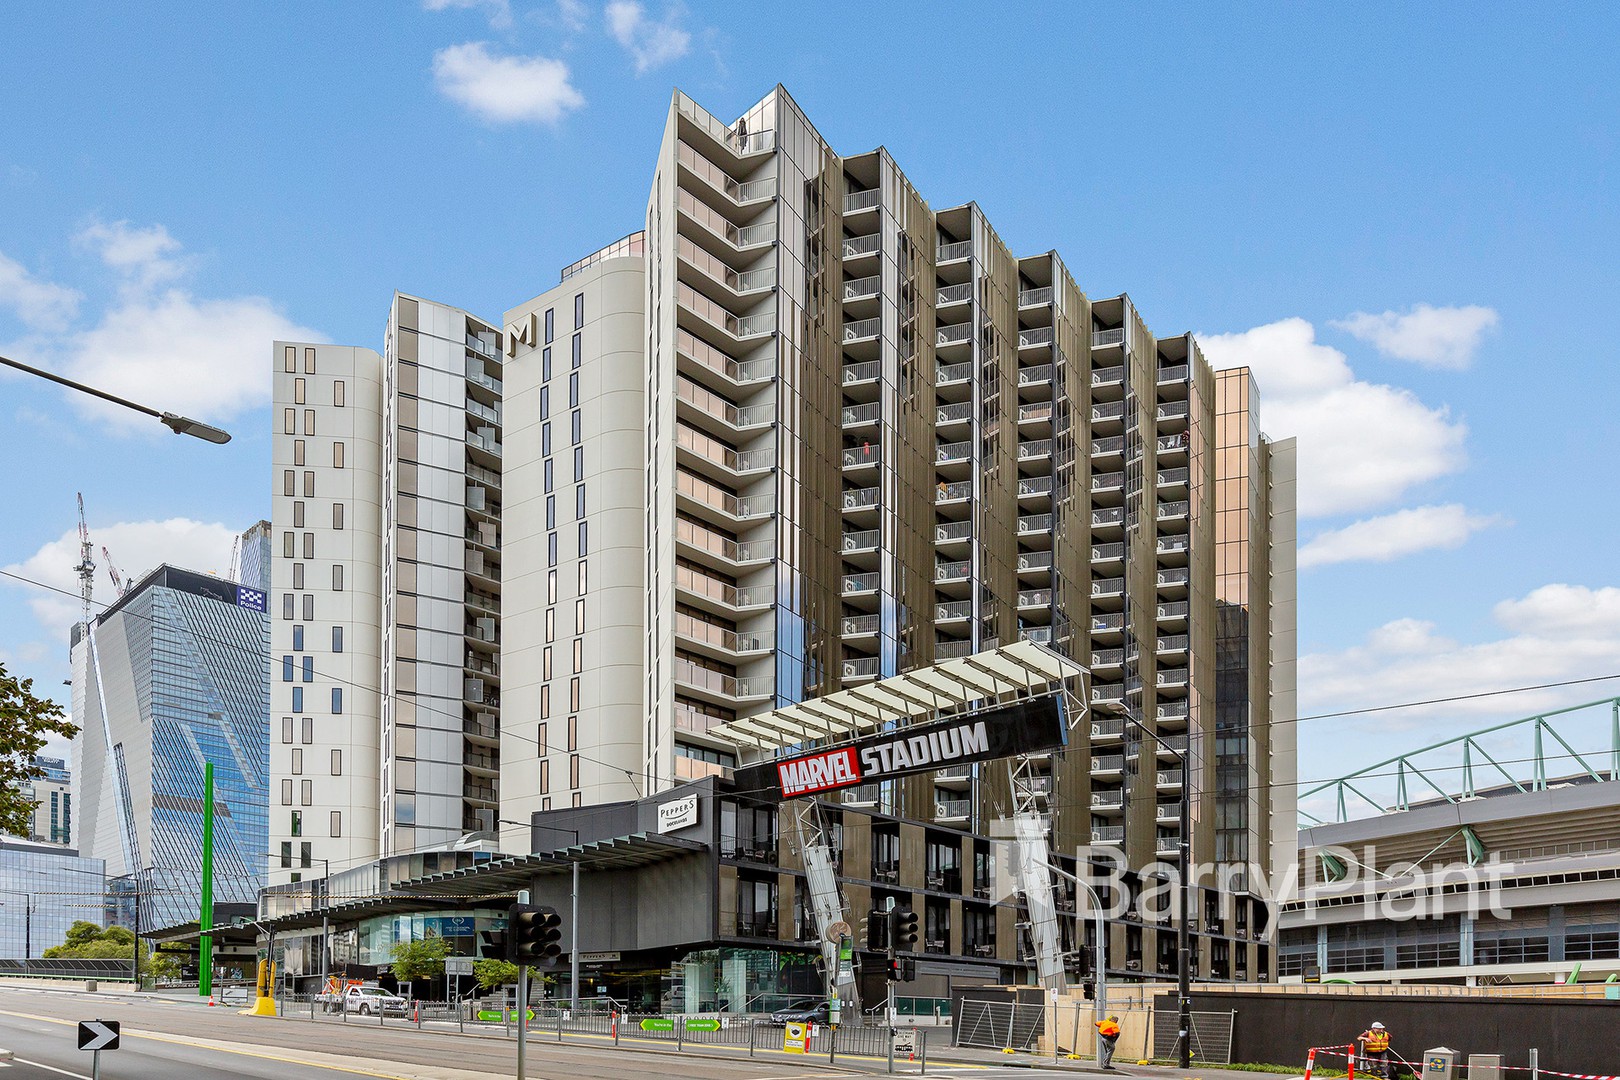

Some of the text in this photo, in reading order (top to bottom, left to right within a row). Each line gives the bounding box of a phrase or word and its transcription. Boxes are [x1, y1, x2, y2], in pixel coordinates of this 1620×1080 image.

[506, 311, 537, 359] M
[240, 601, 262, 610] Police
[778, 721, 990, 795] MARVEL STADIUM
[660, 799, 695, 818] PEPPERS
